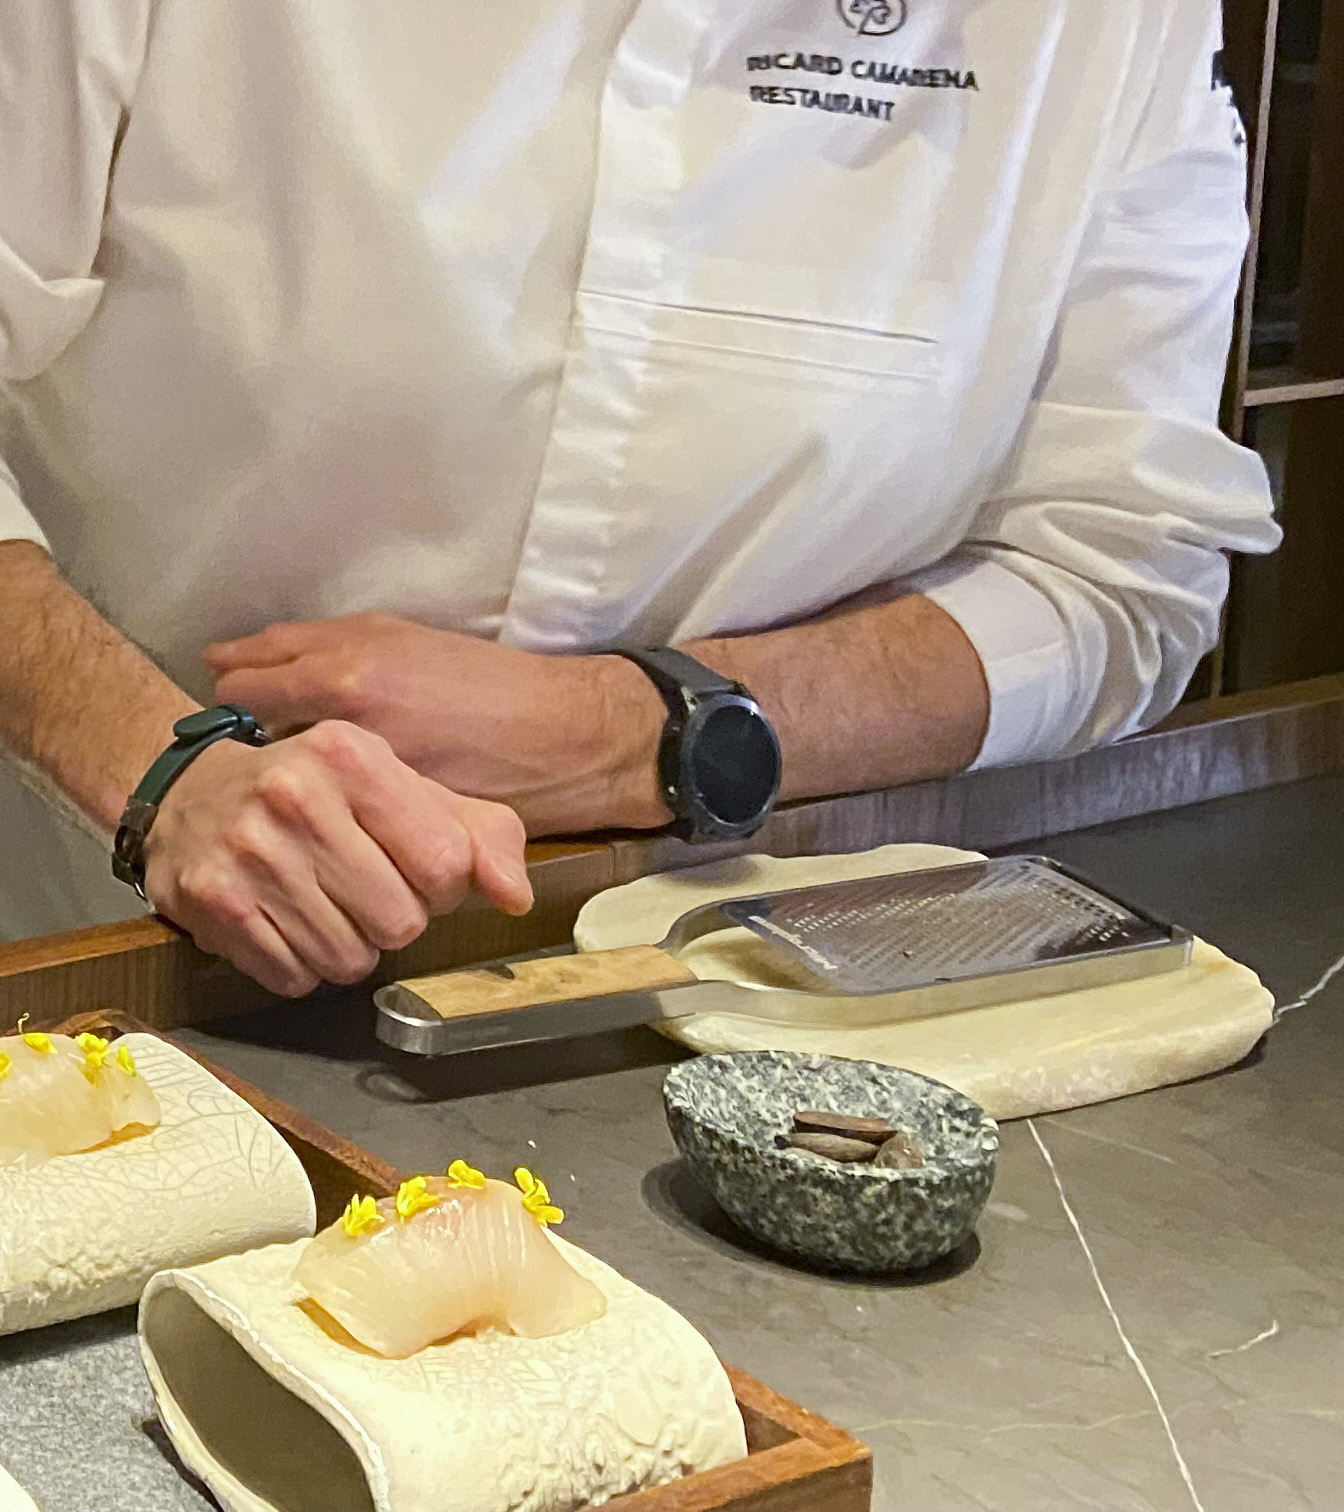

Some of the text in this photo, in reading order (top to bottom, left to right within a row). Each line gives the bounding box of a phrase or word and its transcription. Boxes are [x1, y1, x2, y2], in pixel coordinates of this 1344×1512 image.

[747, 52, 979, 90] RICARD CAMARENA
[749, 85, 895, 121] RESTAURANT
